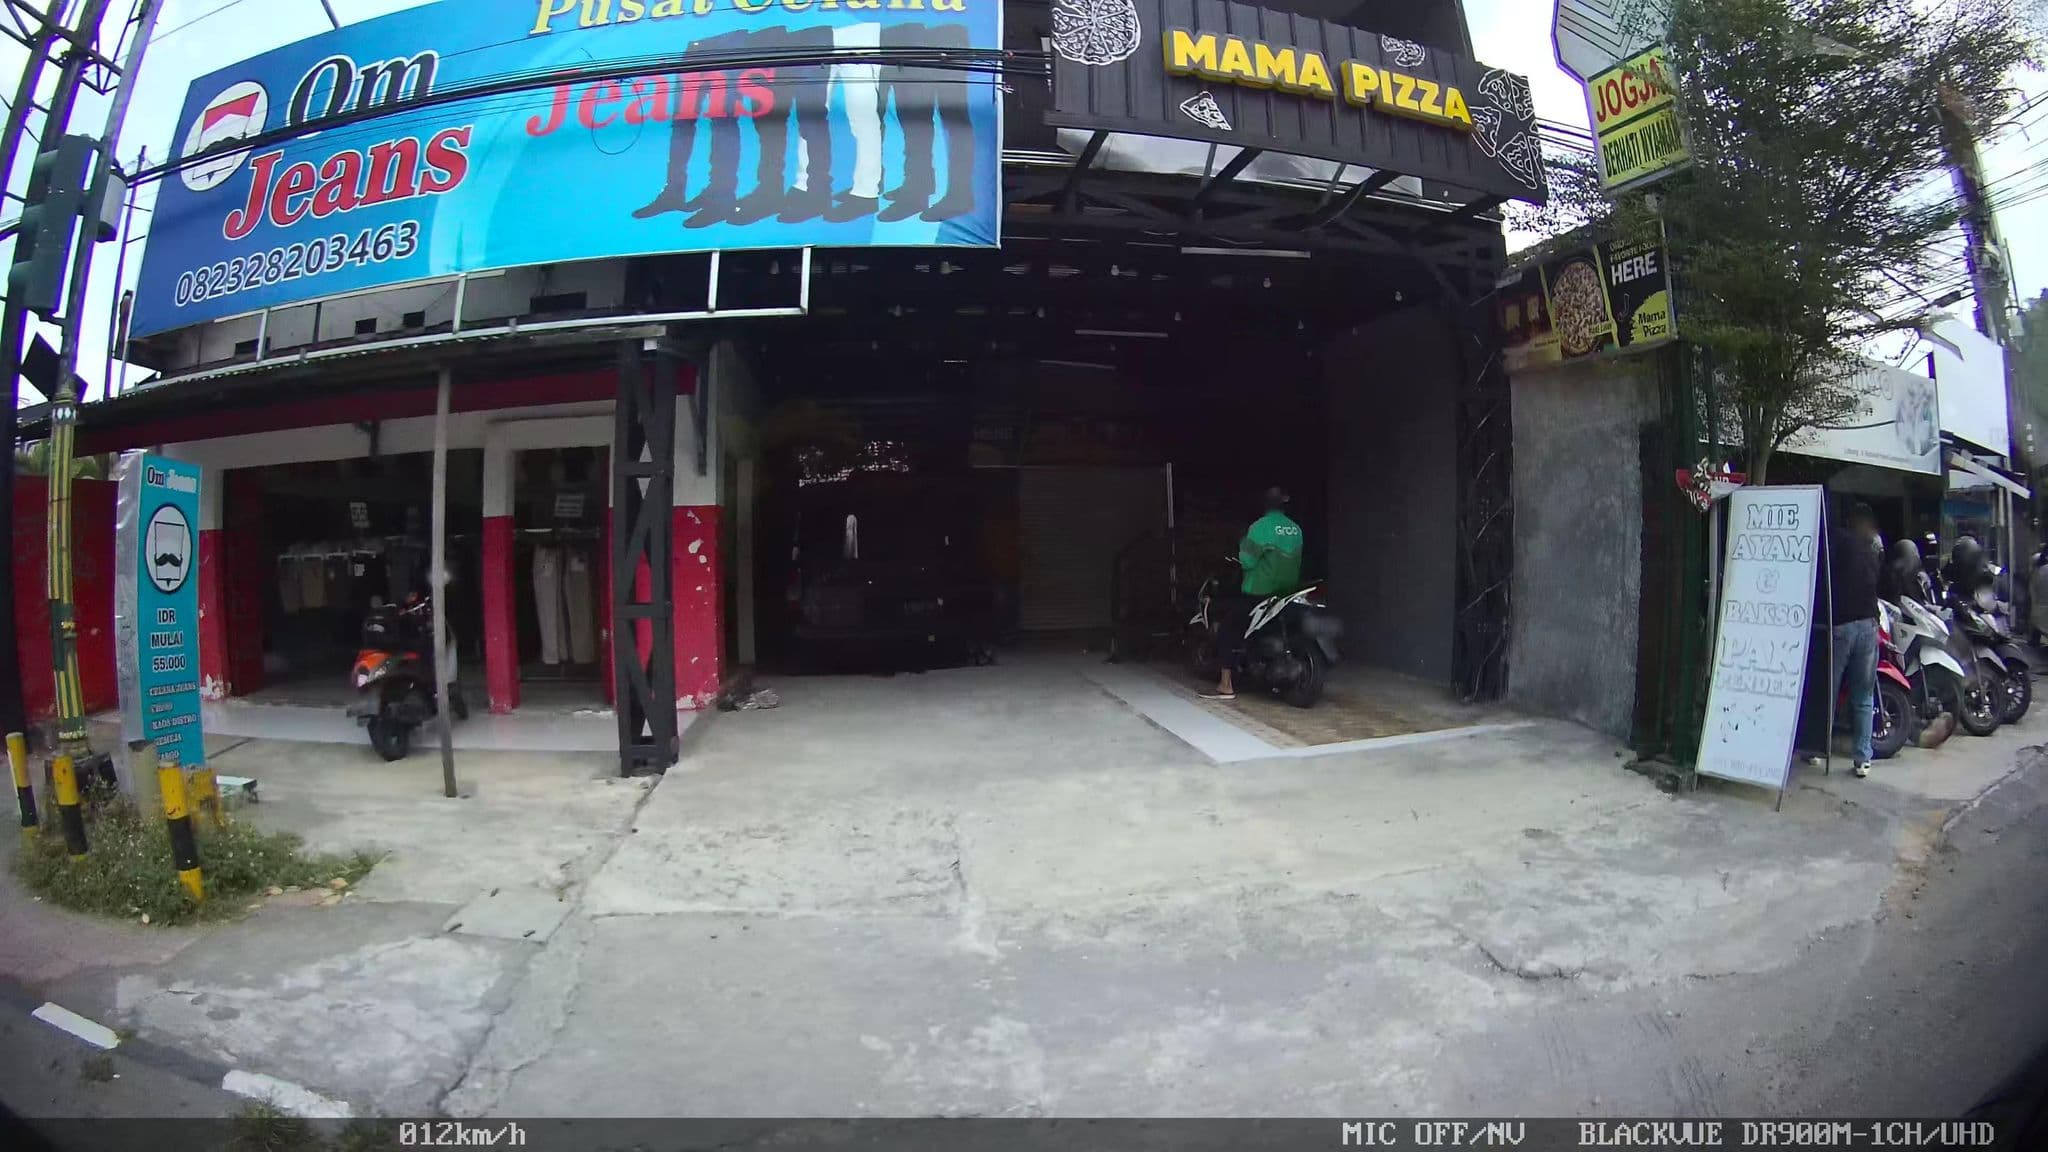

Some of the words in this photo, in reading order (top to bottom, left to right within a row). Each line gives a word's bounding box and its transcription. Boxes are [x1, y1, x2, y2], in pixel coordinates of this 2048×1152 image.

[1168, 29, 1335, 95] MAMA
[1346, 61, 1473, 126] PIZZA
[1596, 57, 1666, 123] JOGJA
[287, 50, 439, 138] Om
[525, 66, 778, 138] Jeans
[223, 123, 474, 240] Jeans
[175, 220, 419, 306] 082328203463
[1611, 251, 1658, 286] HERE
[1638, 310, 1666, 326] Mama
[1642, 323, 1667, 338] Pizza
[147, 465, 165, 488] Om
[1747, 504, 1799, 530] MIE
[1731, 534, 1812, 562] AYAM
[157, 608, 176, 624] IDR
[1724, 600, 1807, 628] BAKSO
[150, 631, 184, 648] MULAI
[152, 654, 187, 672] 55.000
